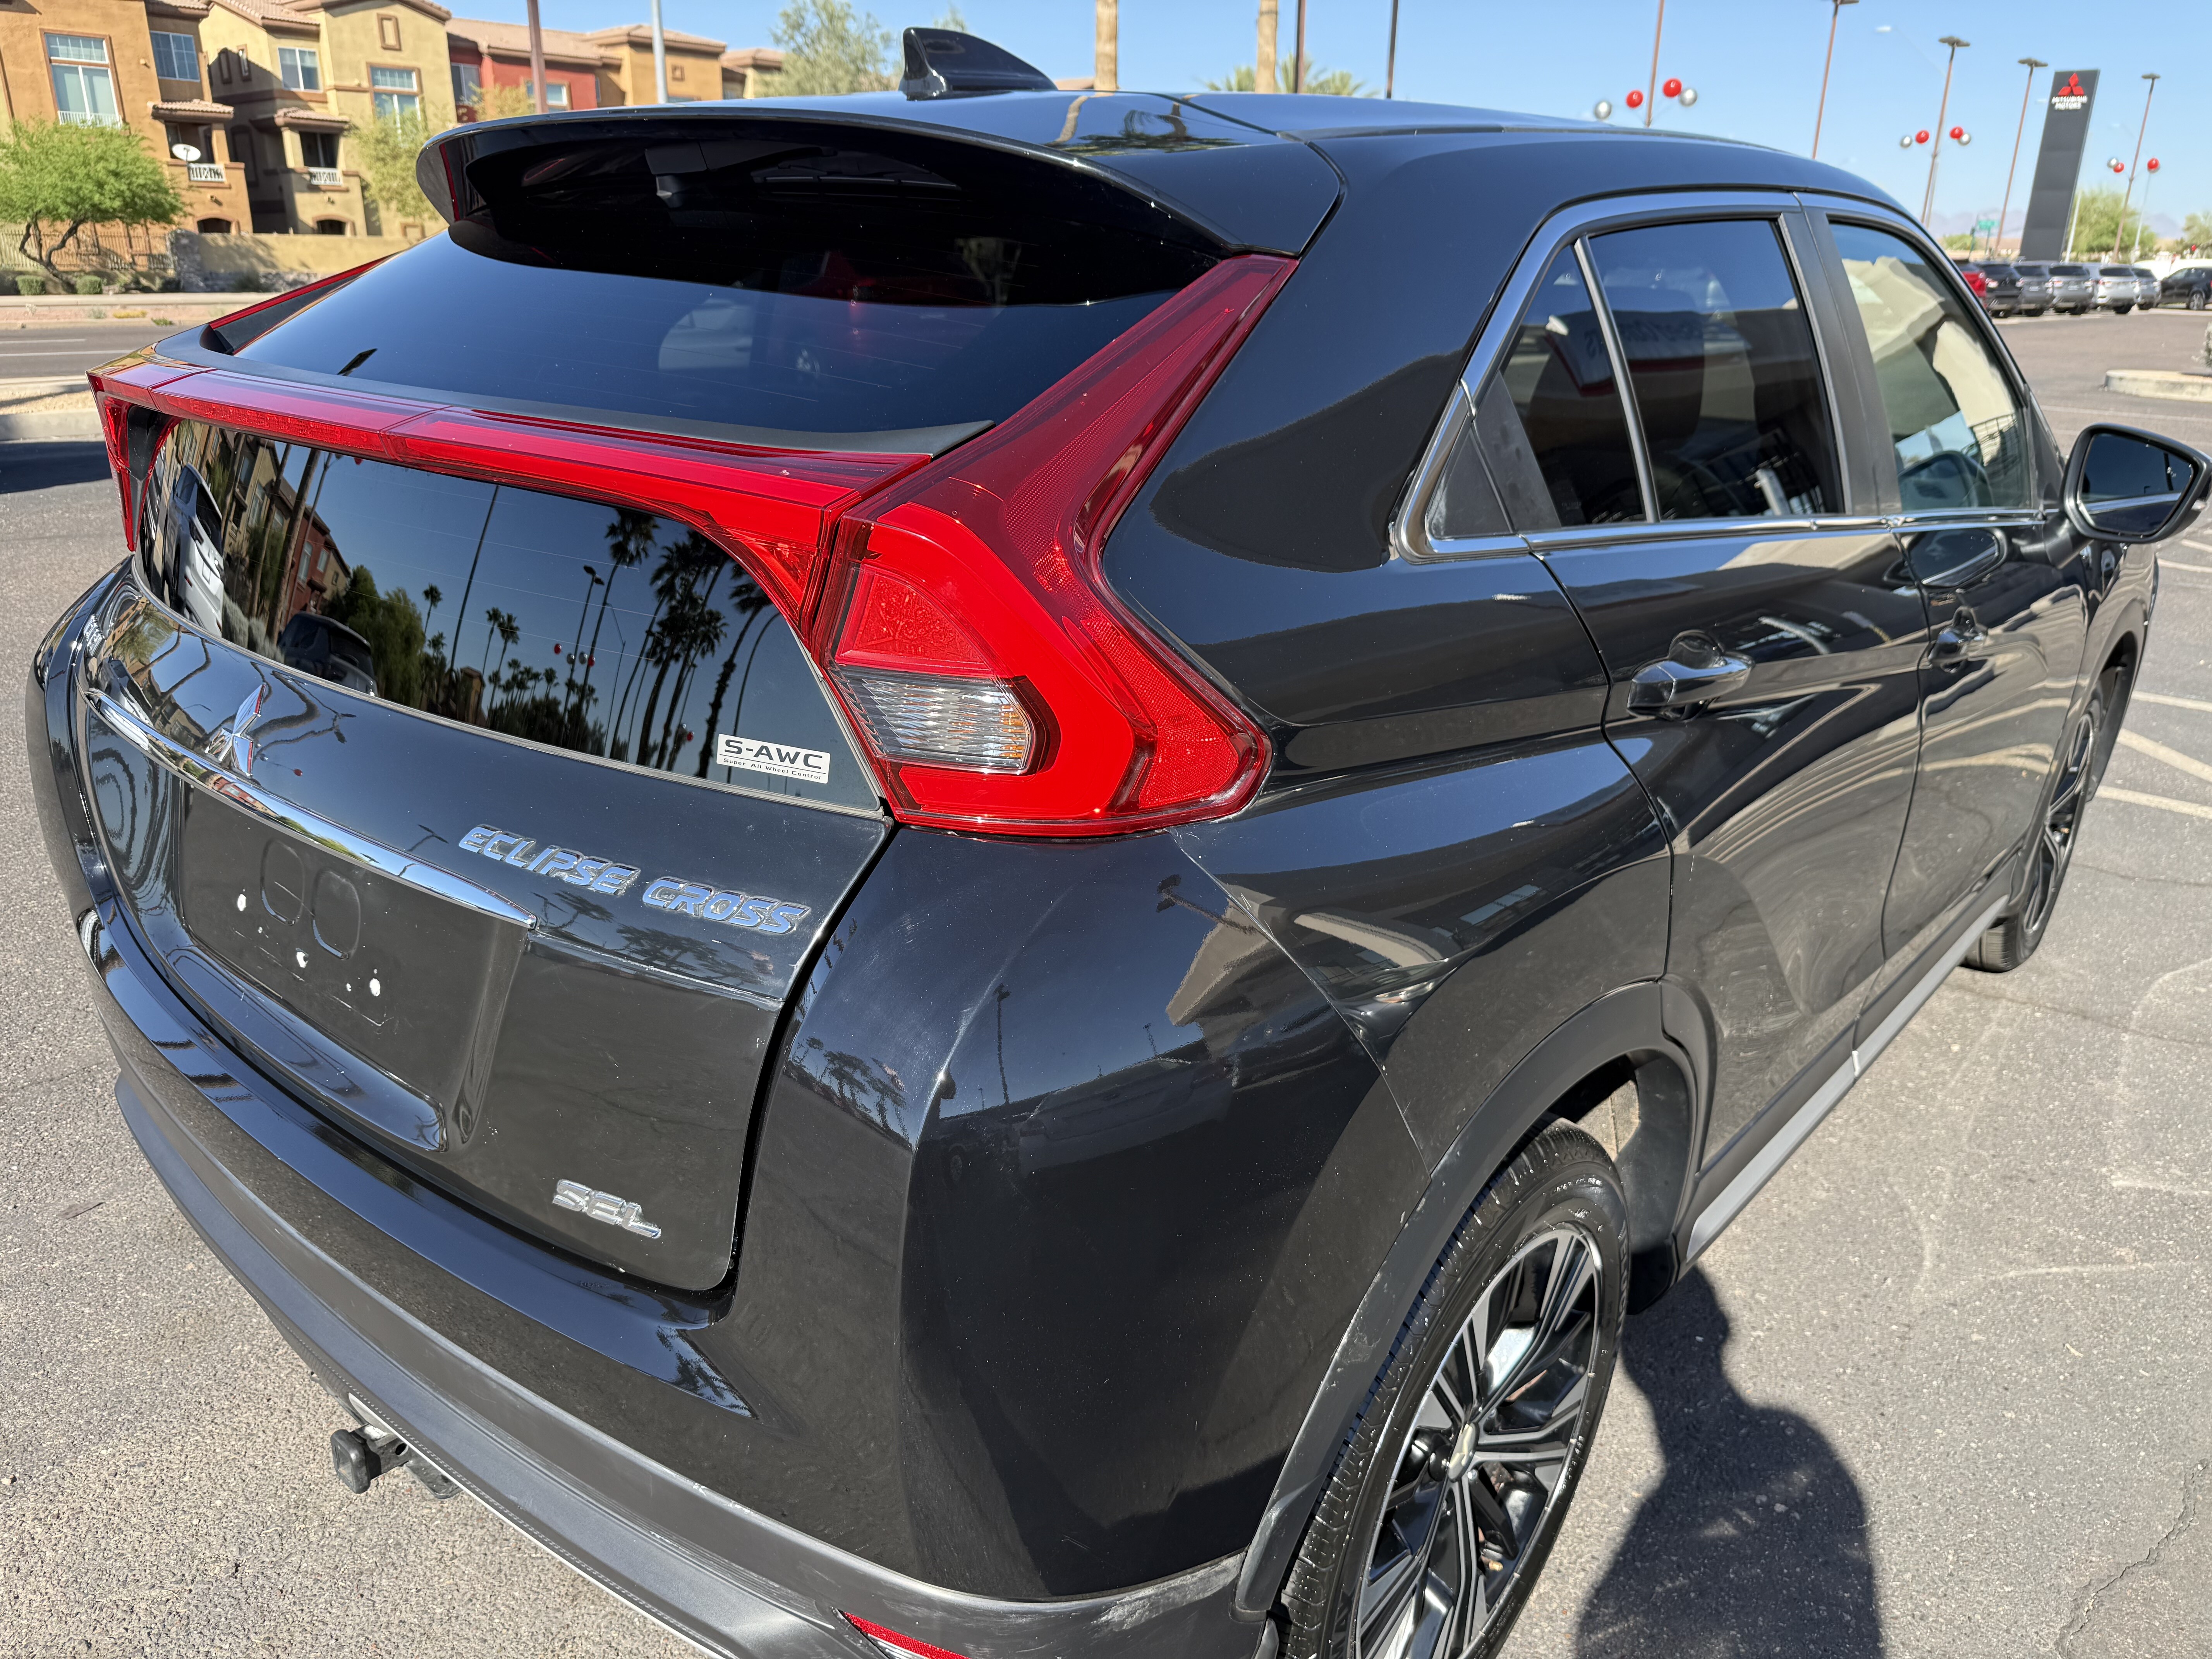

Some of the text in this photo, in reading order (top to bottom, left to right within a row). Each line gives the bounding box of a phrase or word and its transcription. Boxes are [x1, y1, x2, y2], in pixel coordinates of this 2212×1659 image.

[2051, 95, 2087, 104] MITSUBISHI
[2054, 101, 2082, 110] MOTORS
[725, 739, 823, 769] S-AWC
[723, 758, 746, 766] Super
[765, 765, 788, 774] Wheel
[792, 771, 821, 780] Control
[459, 824, 811, 934] ECLIPSE CROSS
[553, 1180, 661, 1239] SEL
